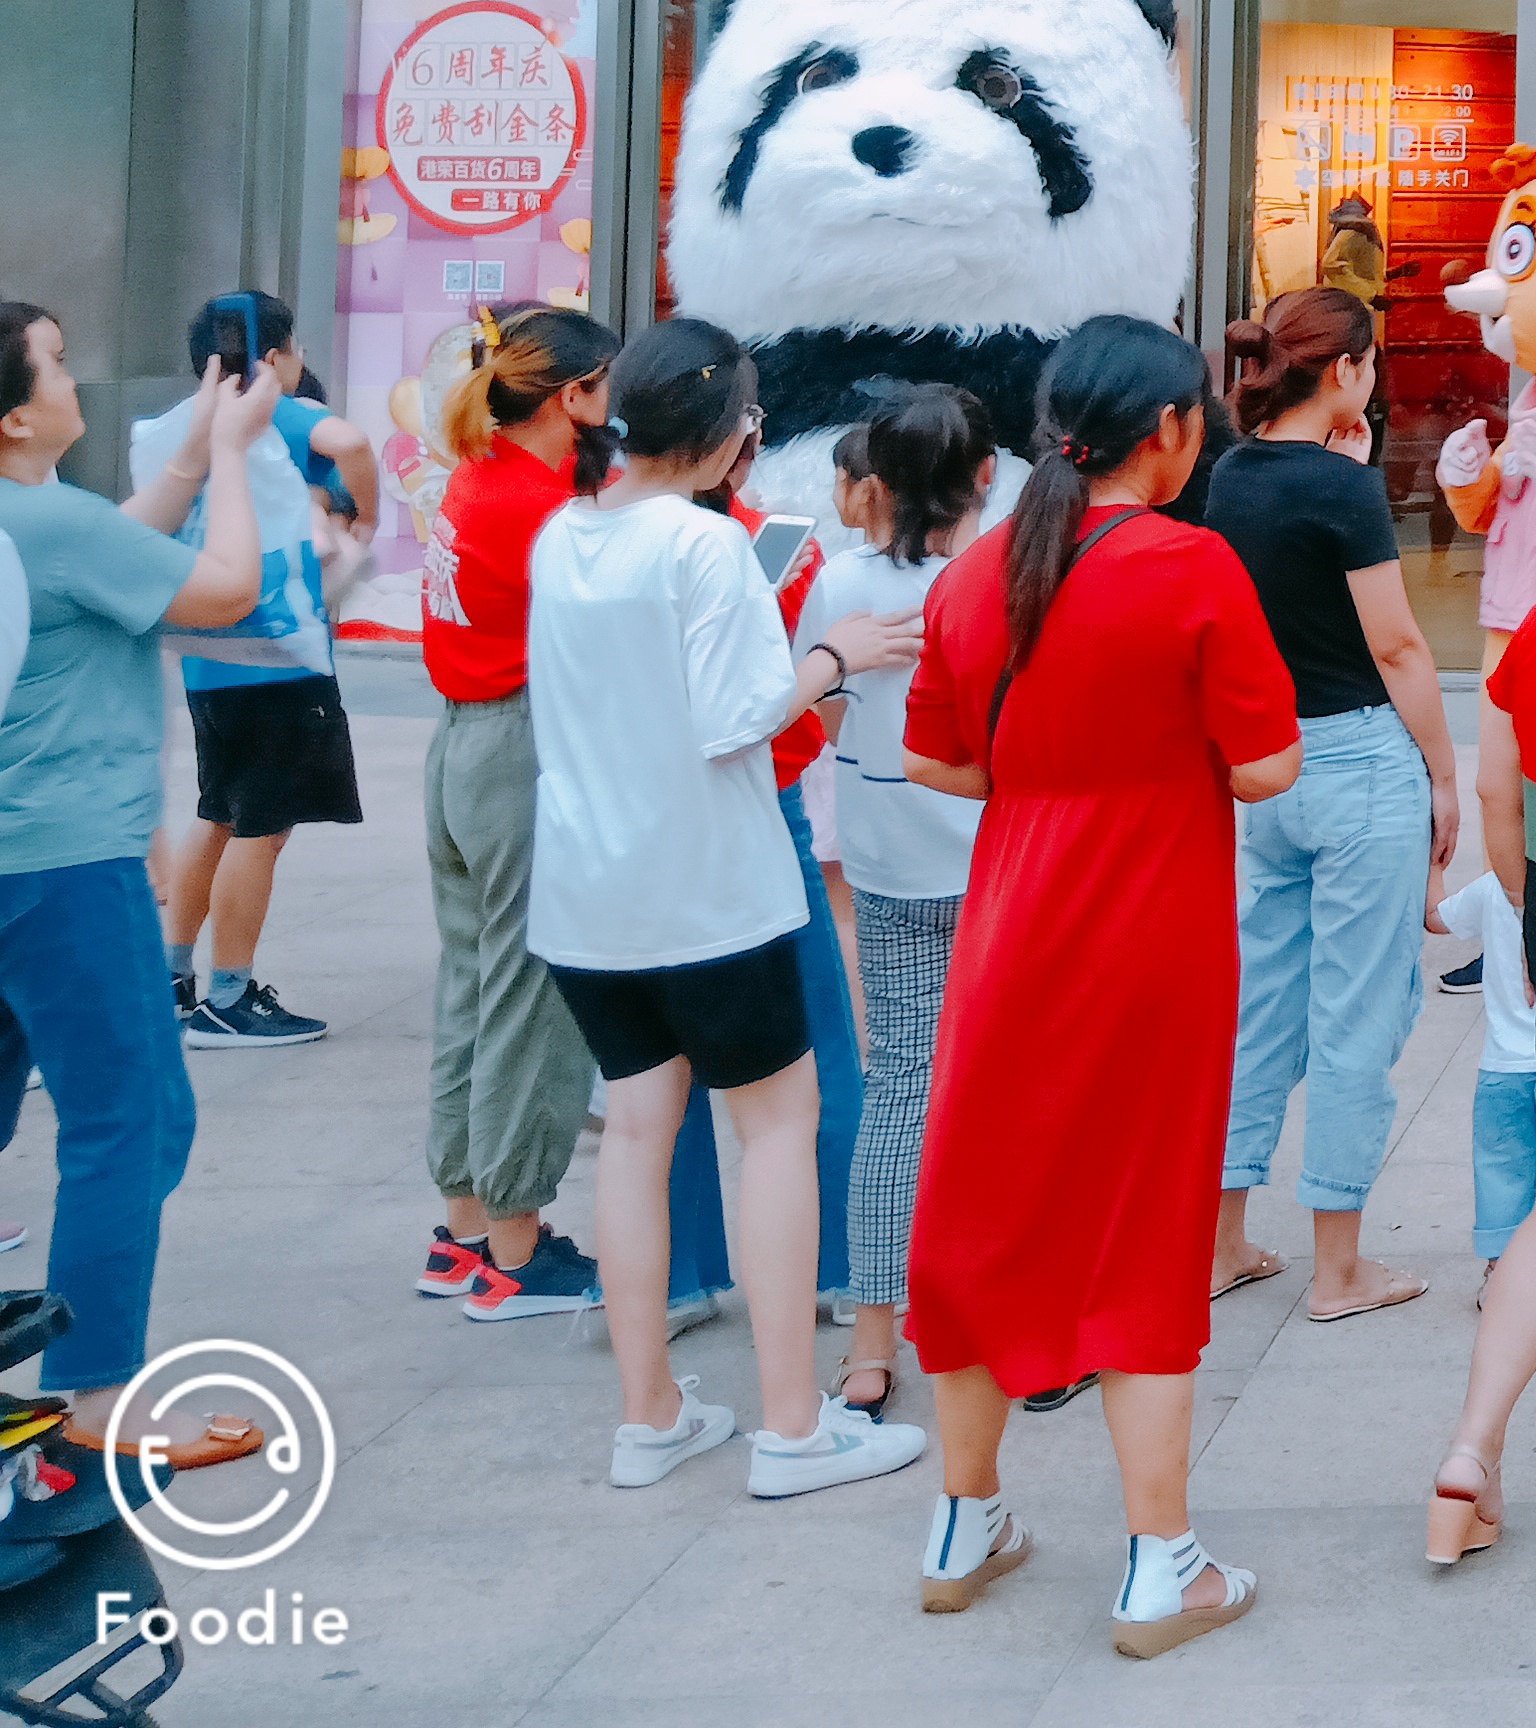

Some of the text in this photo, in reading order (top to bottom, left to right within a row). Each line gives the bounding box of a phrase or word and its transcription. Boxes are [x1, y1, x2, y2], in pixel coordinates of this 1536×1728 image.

[411, 44, 549, 89] 6周年庆
[393, 98, 576, 147] 免费刮金条
[420, 158, 540, 181] 港荣百货6周年
[462, 191, 541, 211] 一路有你
